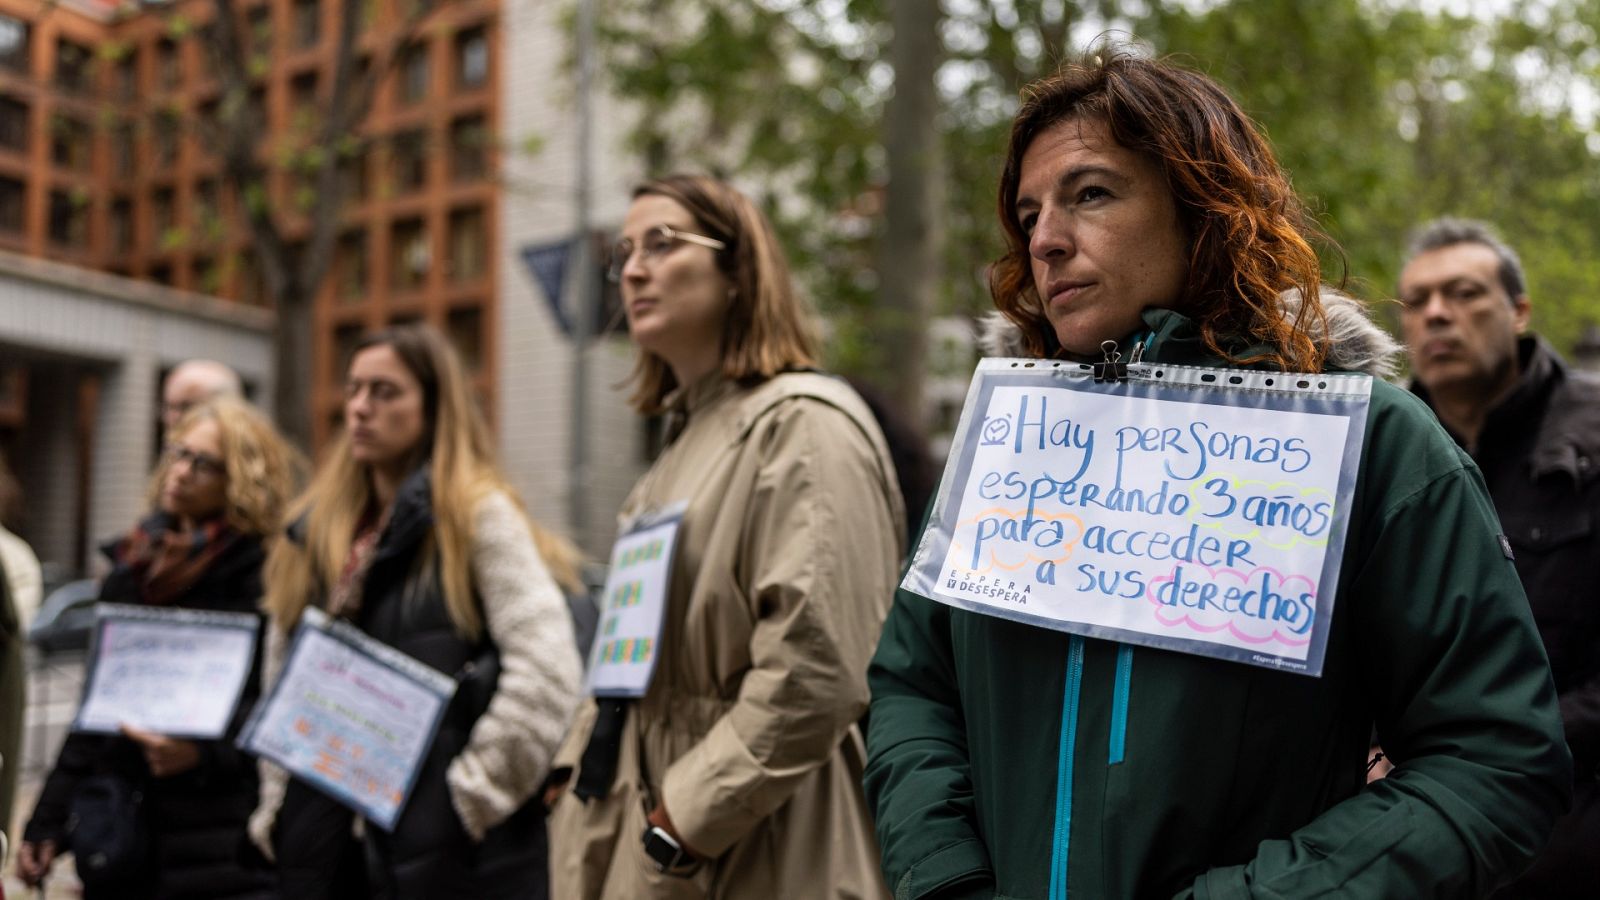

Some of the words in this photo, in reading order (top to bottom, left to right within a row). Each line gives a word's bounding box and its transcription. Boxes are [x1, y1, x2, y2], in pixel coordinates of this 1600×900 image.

[1014, 394, 1095, 485] Hay
[1202, 478, 1237, 518] 3
[1242, 495, 1331, 537] años
[970, 517, 1064, 571] para
[959, 581, 1027, 605] DESESPERA
[1035, 559, 1056, 586] a
[1076, 563, 1146, 599] sus
